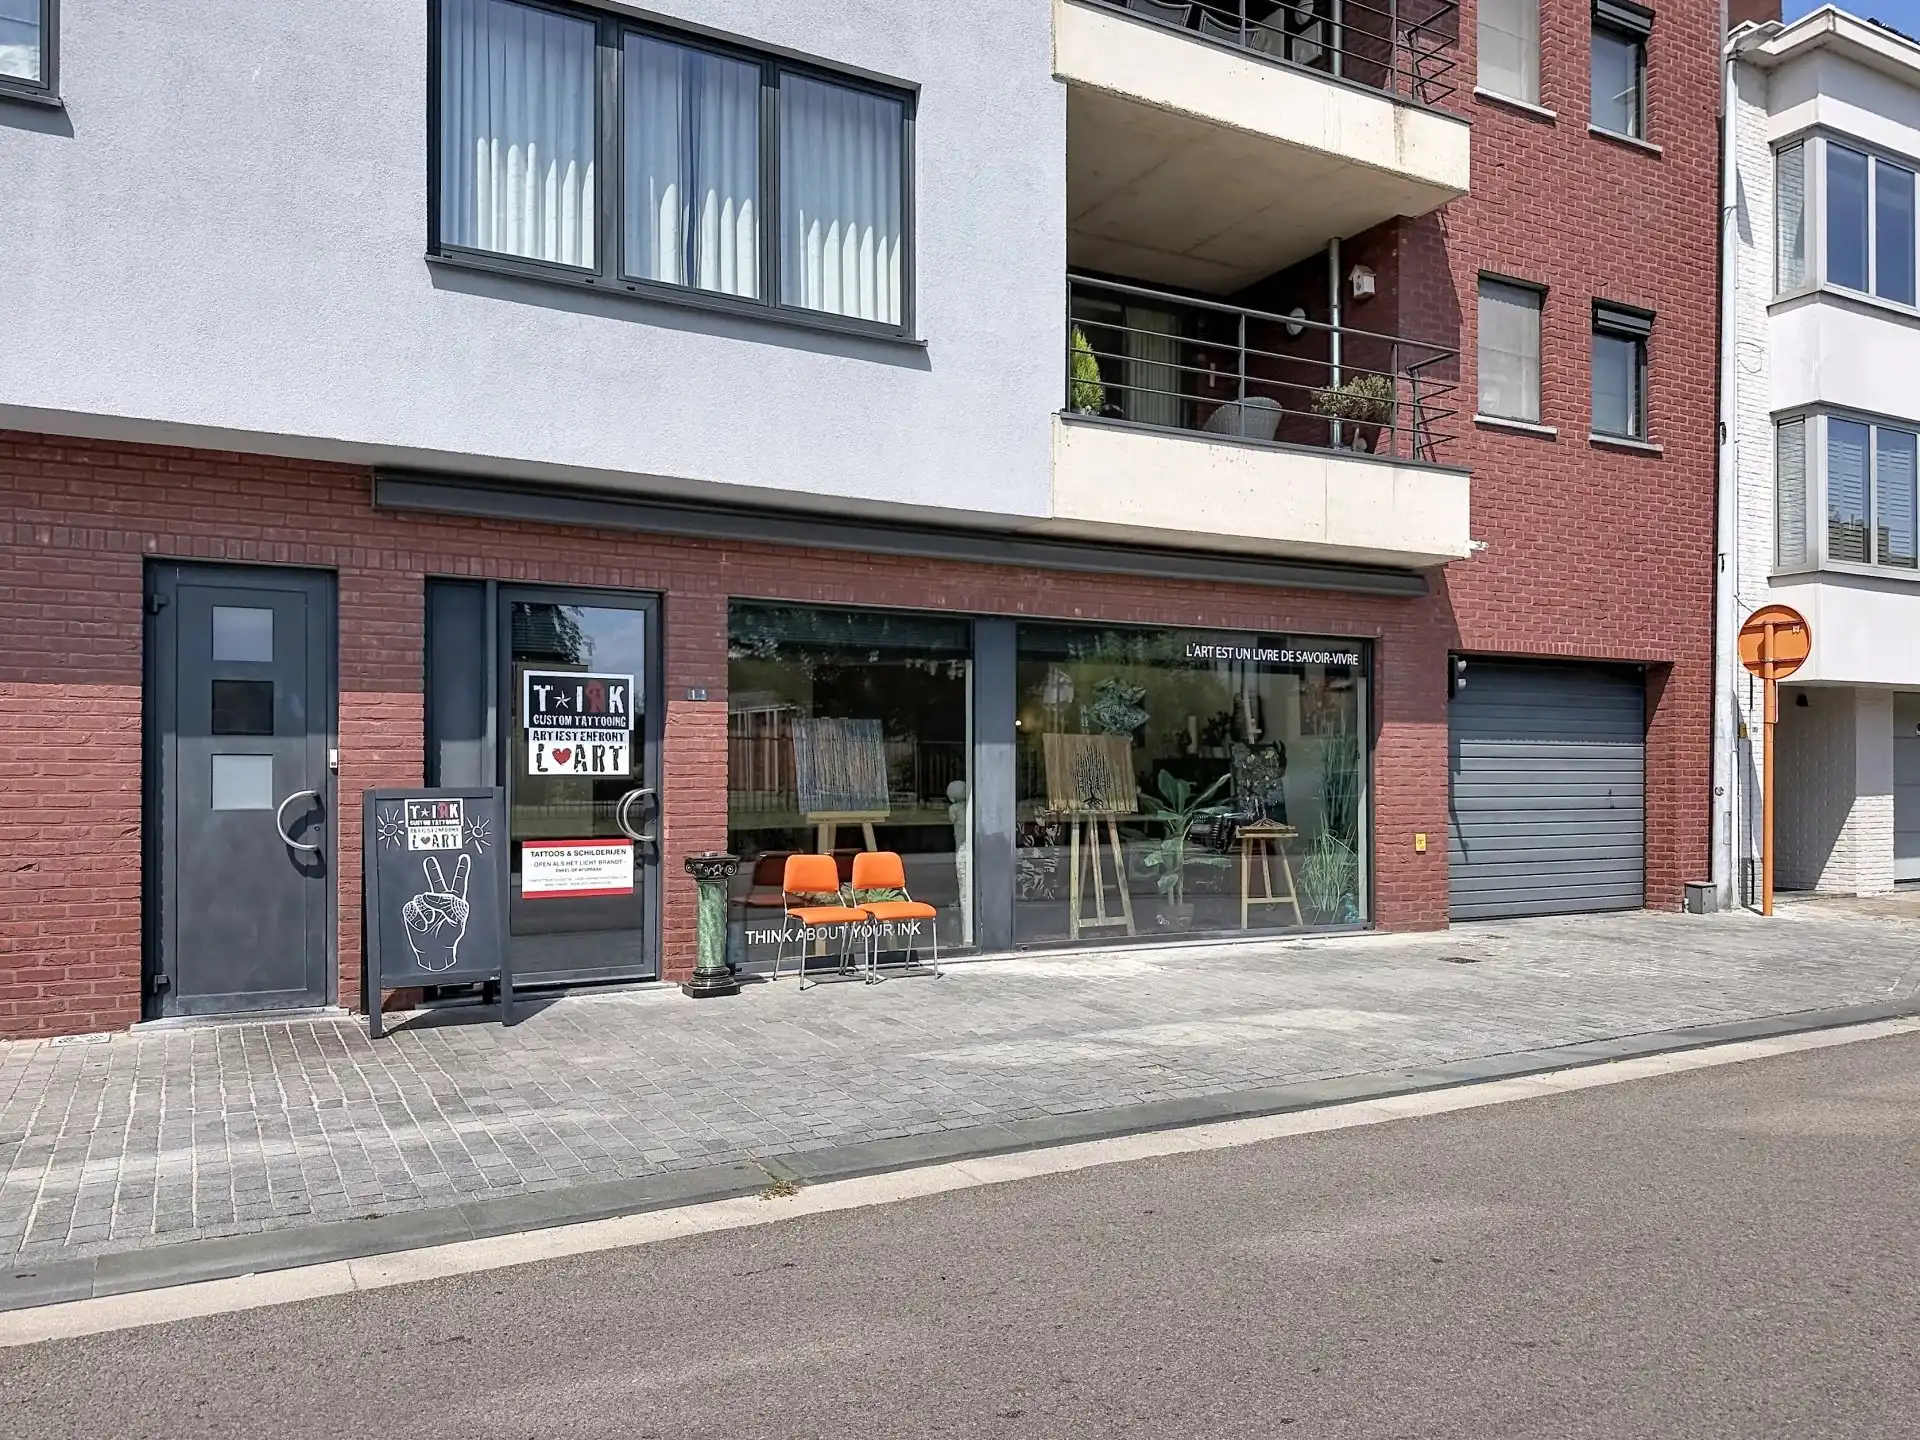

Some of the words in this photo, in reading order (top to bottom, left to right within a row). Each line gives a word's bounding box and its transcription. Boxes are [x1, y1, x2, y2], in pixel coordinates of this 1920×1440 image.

[1186, 642, 1214, 658] L'ART
[1216, 646, 1233, 659] EST
[1235, 647, 1251, 660] UN
[1252, 648, 1279, 662] LIVRE
[1281, 650, 1294, 662] DE
[1295, 650, 1359, 666] SAVOIR-VIVRE
[533, 714, 572, 725] CUSTOM
[574, 715, 627, 727] TATTOOING
[530, 850, 565, 858] TATTOOS
[573, 849, 627, 857] SCHILDERIJEN
[745, 928, 795, 945] THINK
[795, 925, 848, 942] ABOUT
[852, 923, 893, 938] YOUR
[897, 921, 922, 936] INK
